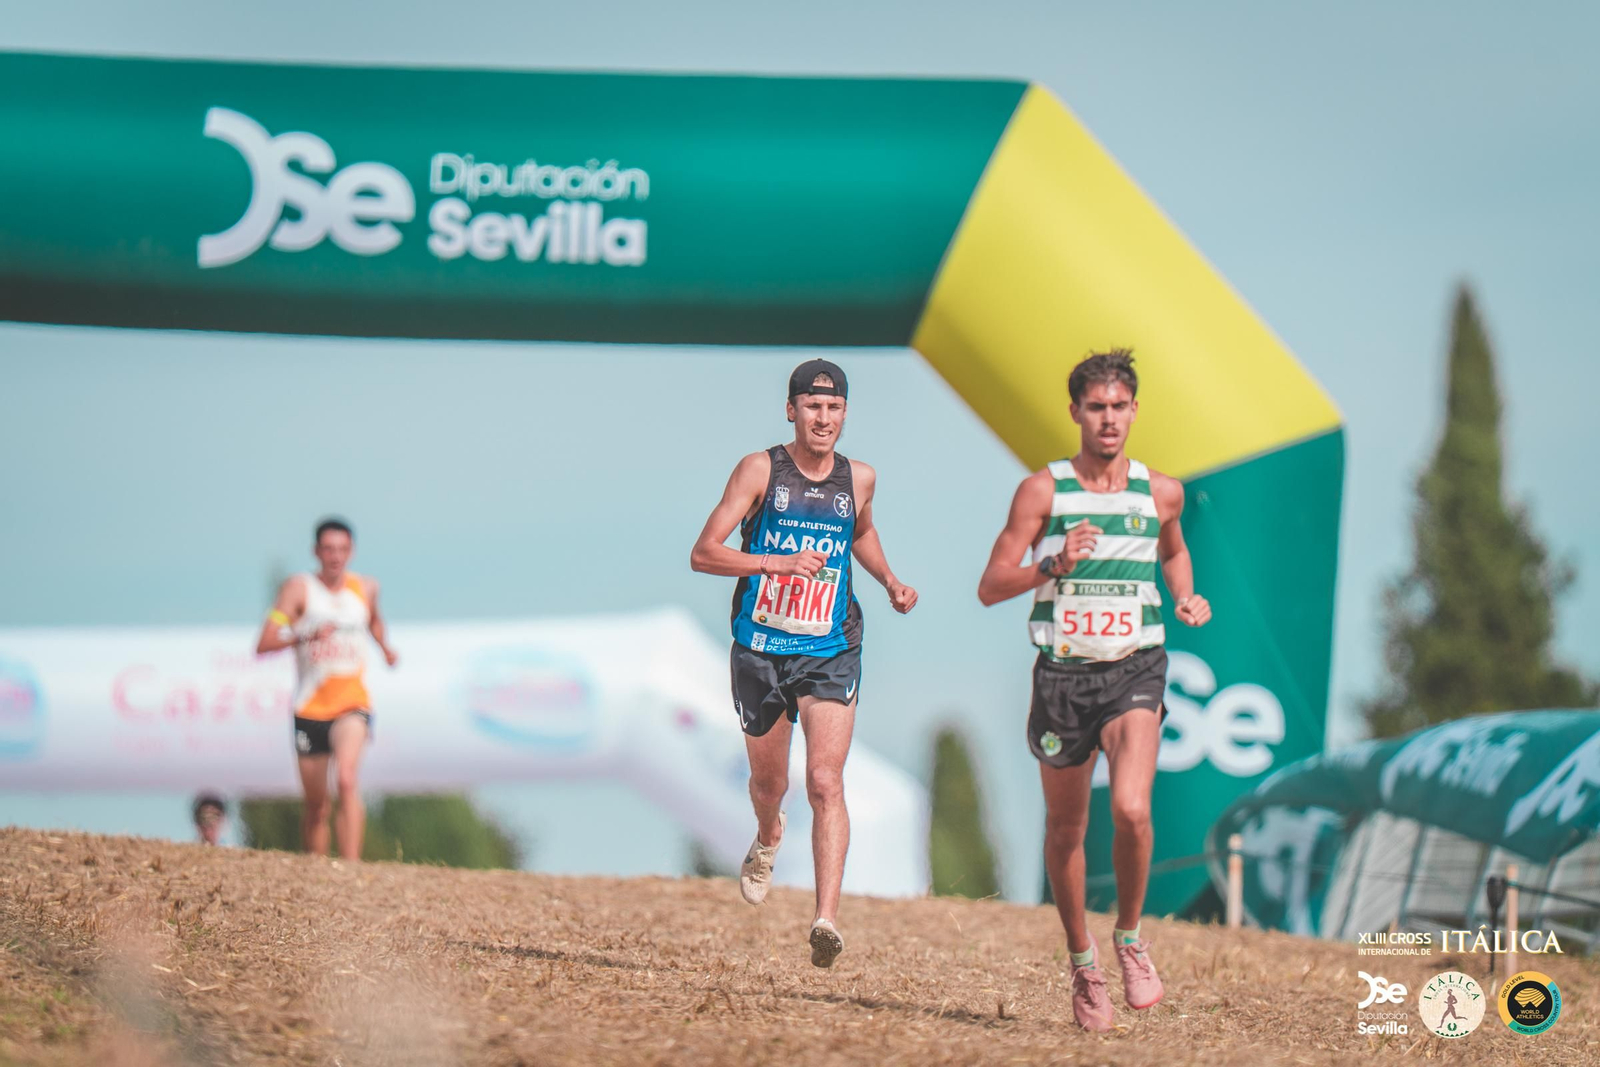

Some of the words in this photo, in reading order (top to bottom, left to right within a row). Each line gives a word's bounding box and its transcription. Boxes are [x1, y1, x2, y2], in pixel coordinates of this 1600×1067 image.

[428, 152, 650, 201] Diputación
[427, 198, 648, 266] Sevilla
[804, 490, 825, 499] amura
[778, 518, 799, 528] CLUB
[799, 521, 843, 533] ATLETISMO
[764, 529, 847, 558] NARÓN
[756, 573, 836, 622] ATRIKI
[1062, 610, 1133, 637] 5125
